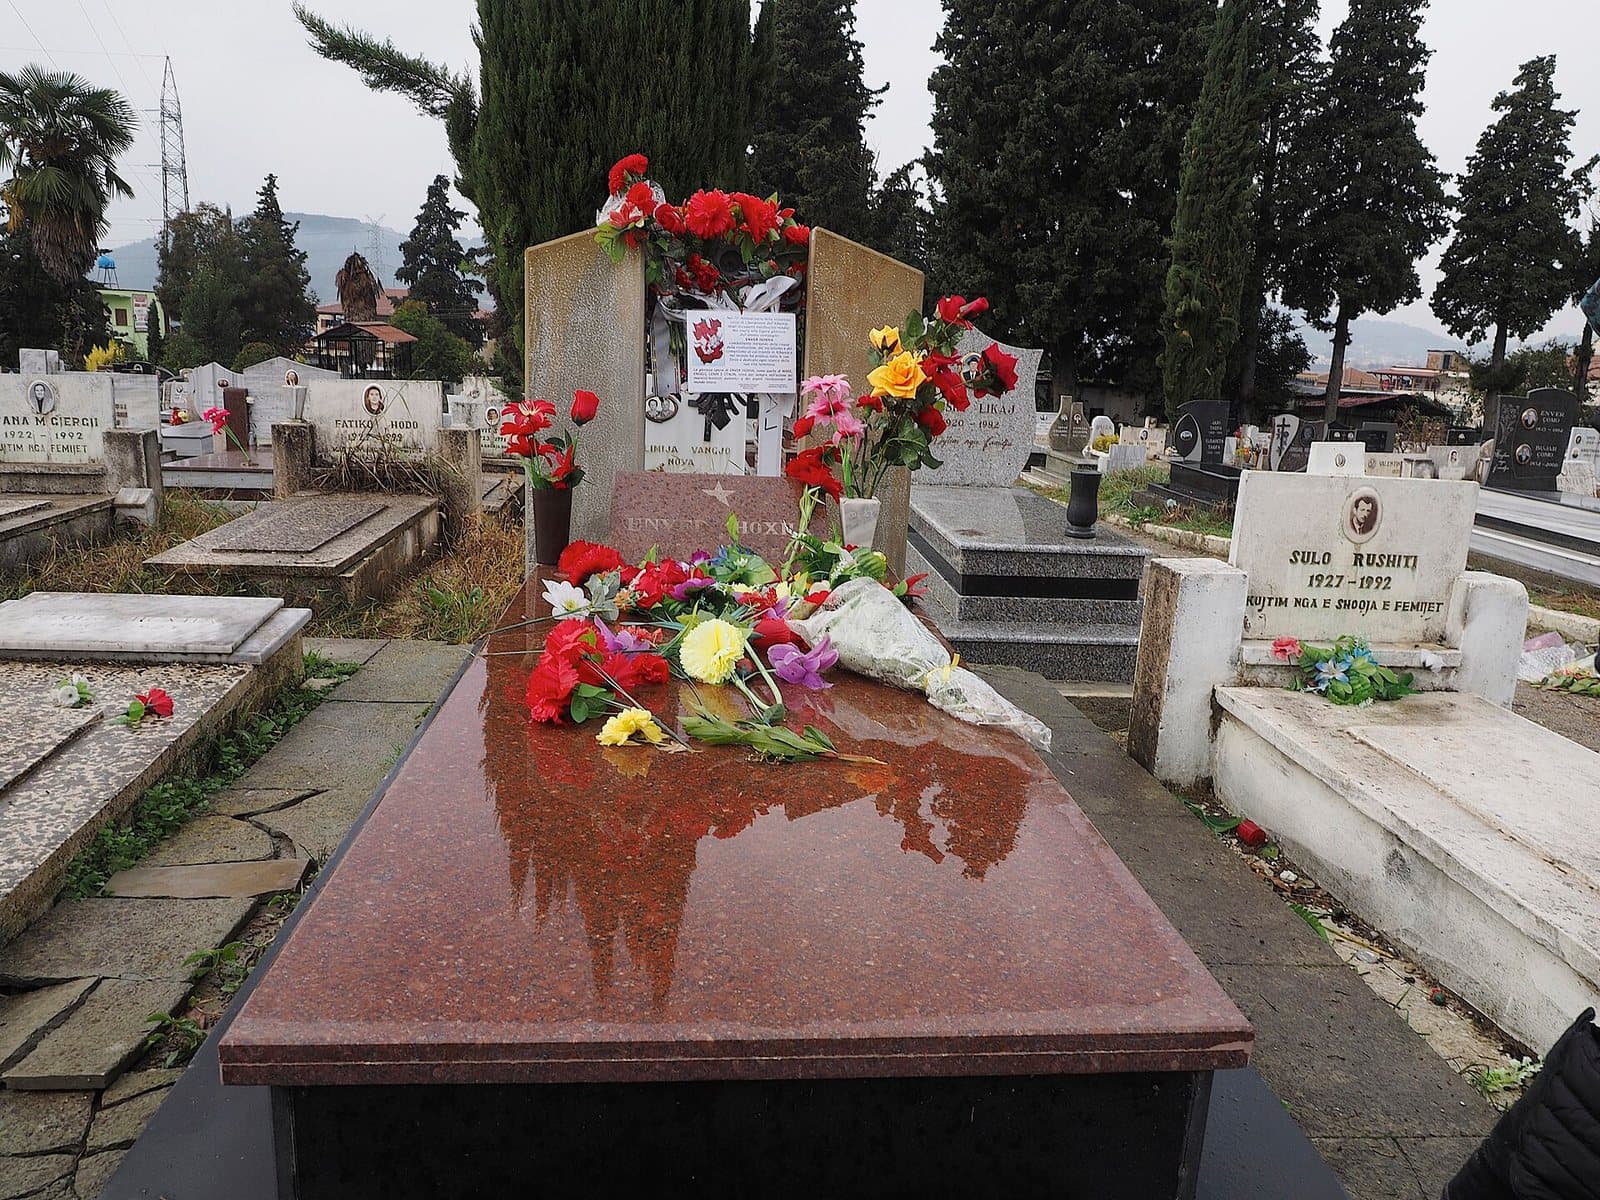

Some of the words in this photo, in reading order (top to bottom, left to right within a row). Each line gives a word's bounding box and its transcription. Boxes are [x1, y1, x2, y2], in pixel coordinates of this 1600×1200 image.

[979, 403, 1015, 415] LIKAJ
[0, 416, 30, 426] ANA
[335, 419, 374, 429] FATIKO
[390, 420, 419, 430] HODO
[946, 418, 964, 427] 920
[4, 430, 33, 439] 1922
[55, 431, 84, 440] 1992
[736, 519, 795, 535] HOXH
[1288, 549, 1332, 566] SULO
[1352, 552, 1418, 570] RUSHITI
[1246, 595, 1289, 613] KUJTIM
[1293, 597, 1318, 610] NGA
[1322, 598, 1331, 609] E
[1382, 600, 1390, 610] E
